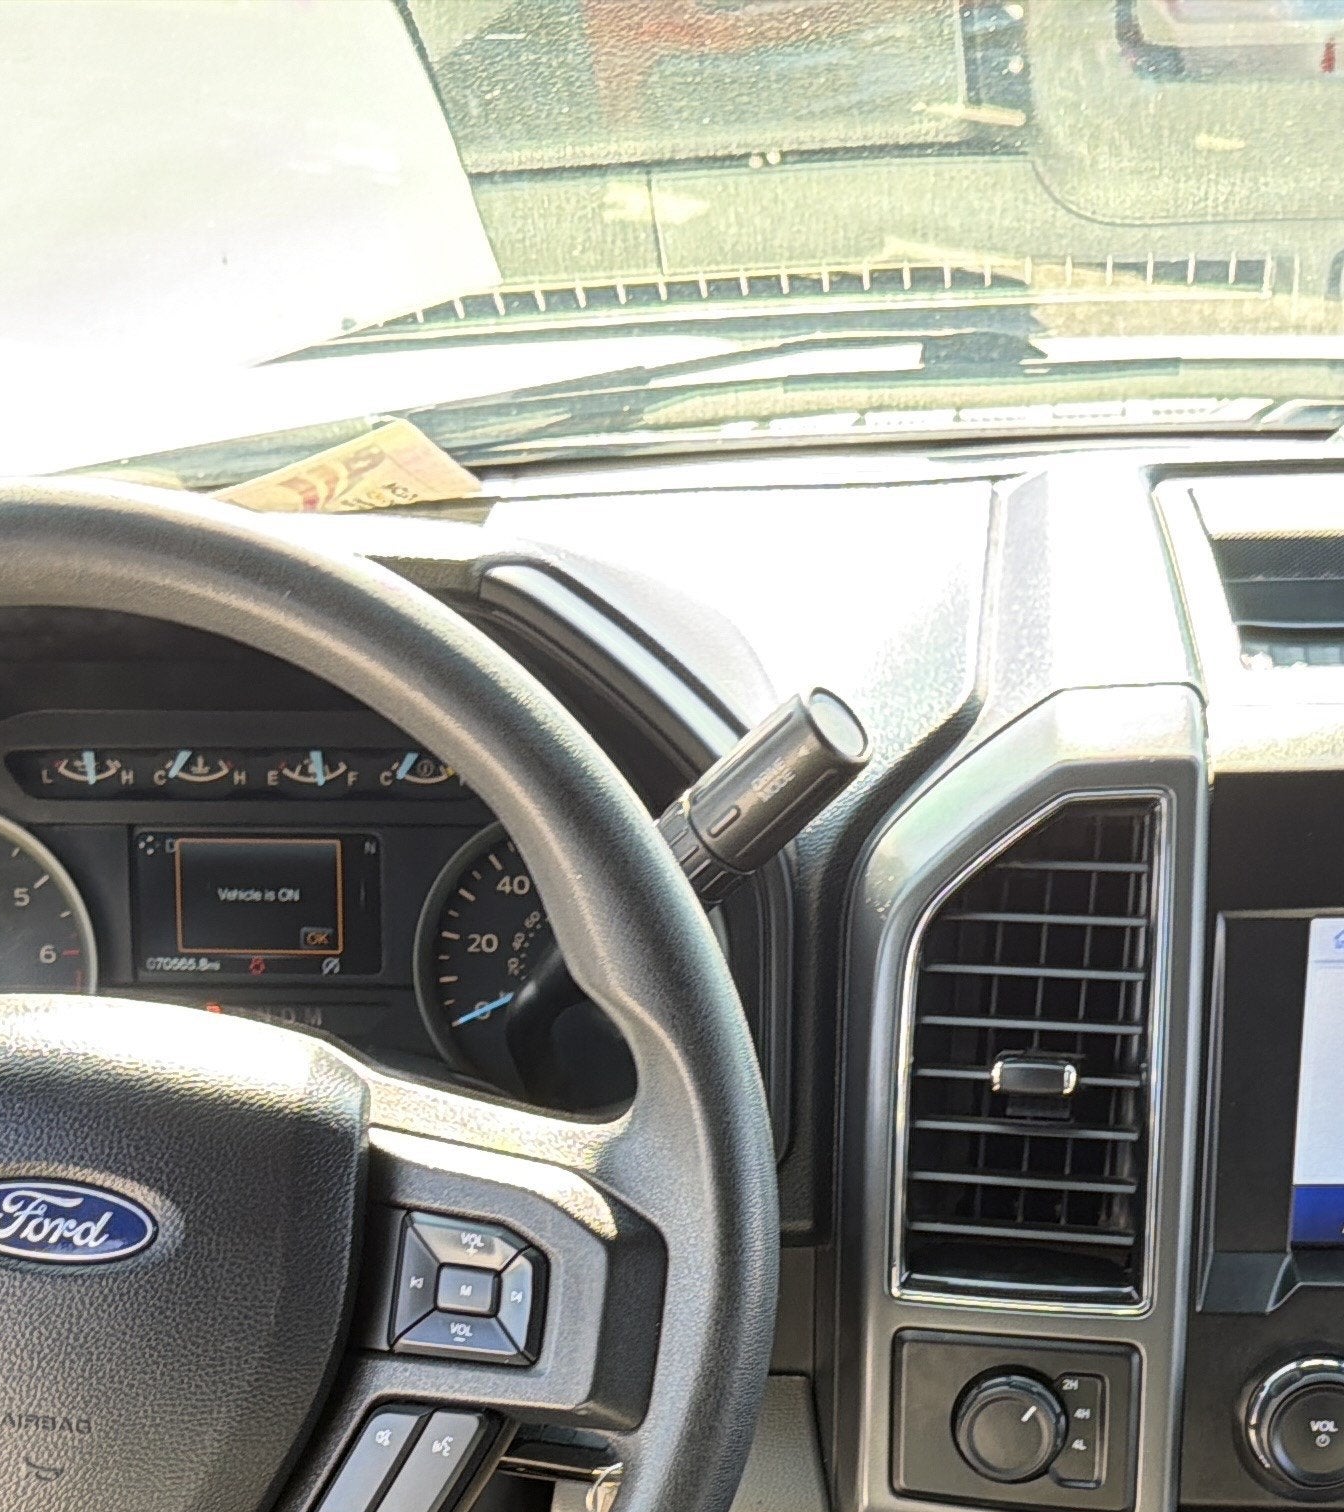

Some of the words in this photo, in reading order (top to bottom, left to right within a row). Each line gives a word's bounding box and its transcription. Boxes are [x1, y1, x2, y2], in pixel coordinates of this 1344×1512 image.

[233, 771, 246, 786] H
[267, 771, 279, 787] E
[347, 771, 359, 787] F
[496, 874, 531, 896] 40
[13, 887, 31, 908] 5
[216, 887, 262, 902] Vehicle
[277, 887, 300, 902] ON
[467, 932, 499, 954] 20
[38, 944, 57, 964] 6
[460, 1231, 485, 1248] VOL
[459, 1284, 473, 1298] M
[449, 1322, 473, 1338] VOL
[1062, 1378, 1079, 1391] 2H
[1073, 1408, 1091, 1420] 4H
[0, 1413, 92, 1436] AIRBAG
[1309, 1420, 1339, 1433] VOL
